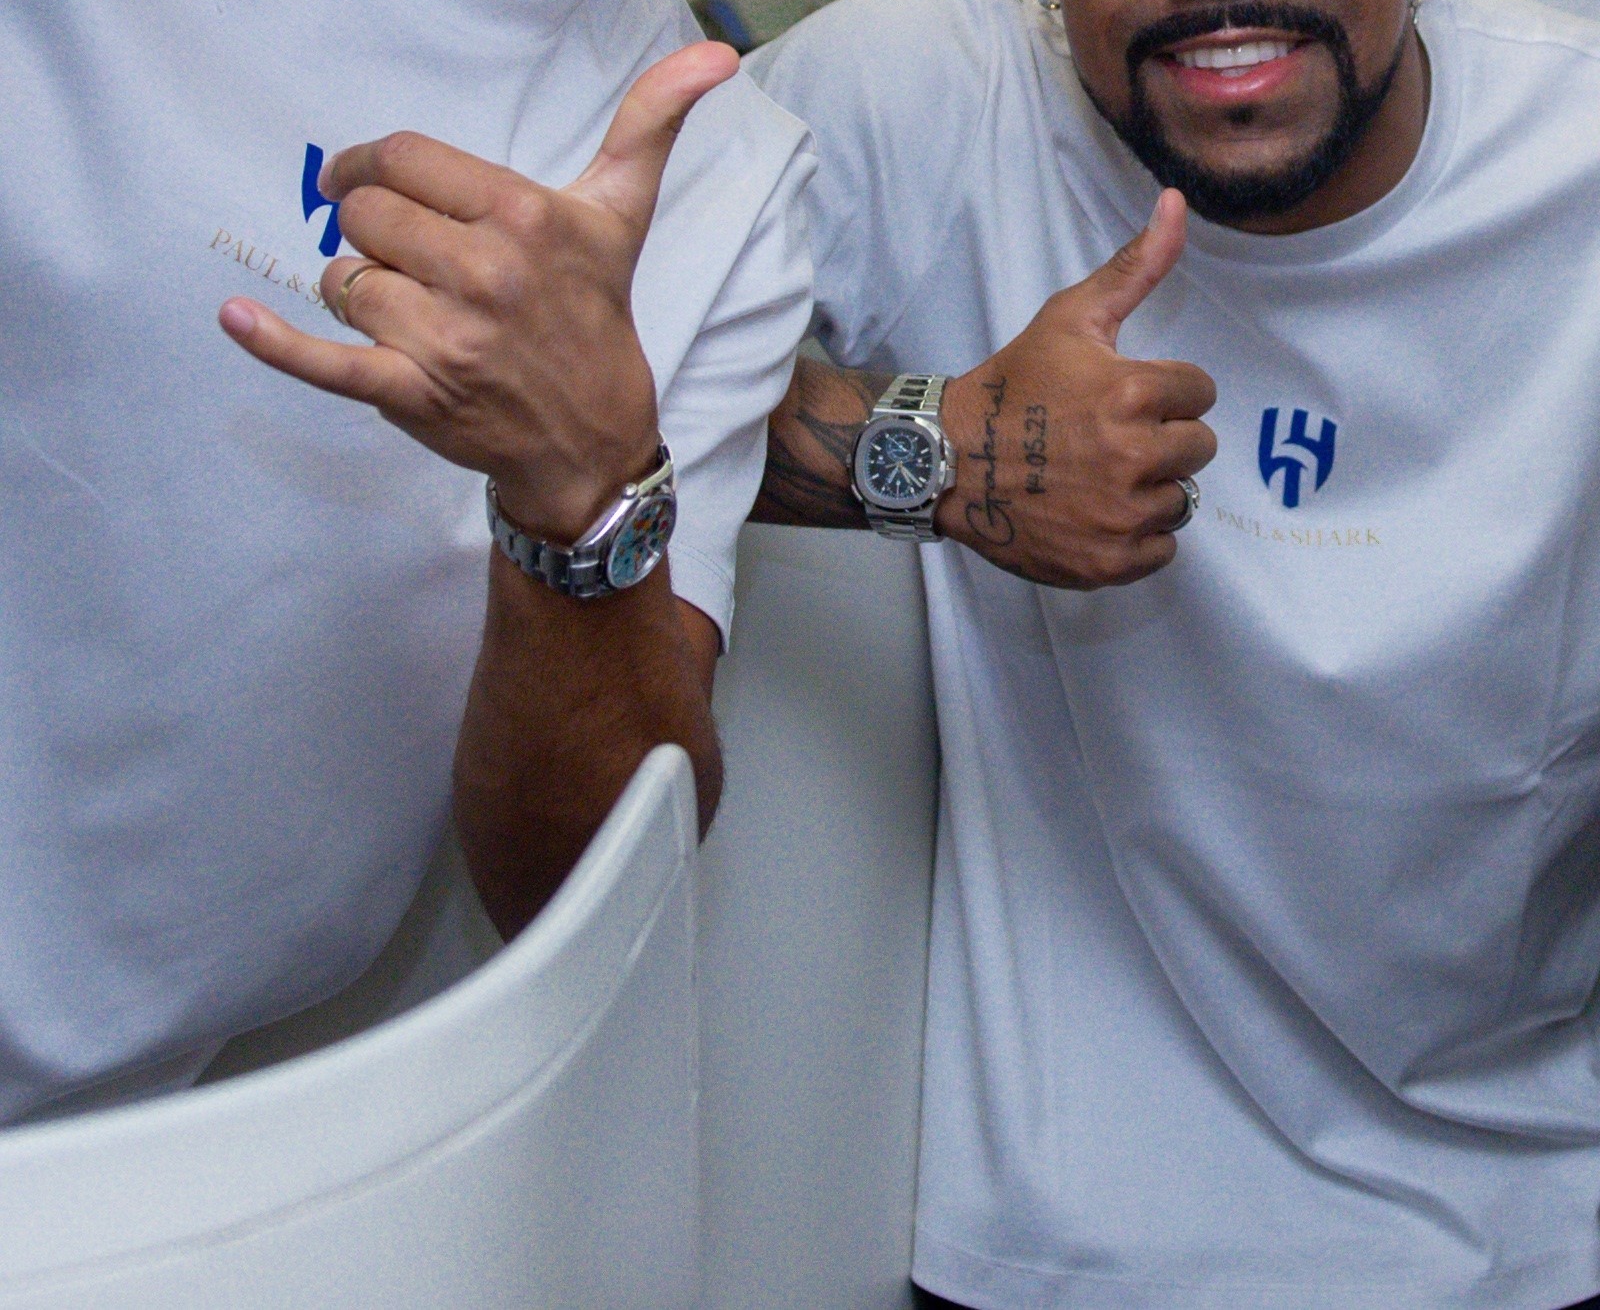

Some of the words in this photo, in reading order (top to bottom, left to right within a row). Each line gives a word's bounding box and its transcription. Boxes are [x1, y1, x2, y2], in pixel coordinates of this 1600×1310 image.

[209, 227, 281, 285] PAUL
[305, 280, 329, 310] S
[965, 377, 1016, 547] Gabriel
[1215, 506, 1268, 540] PAUL
[1290, 527, 1382, 547] SHARK
